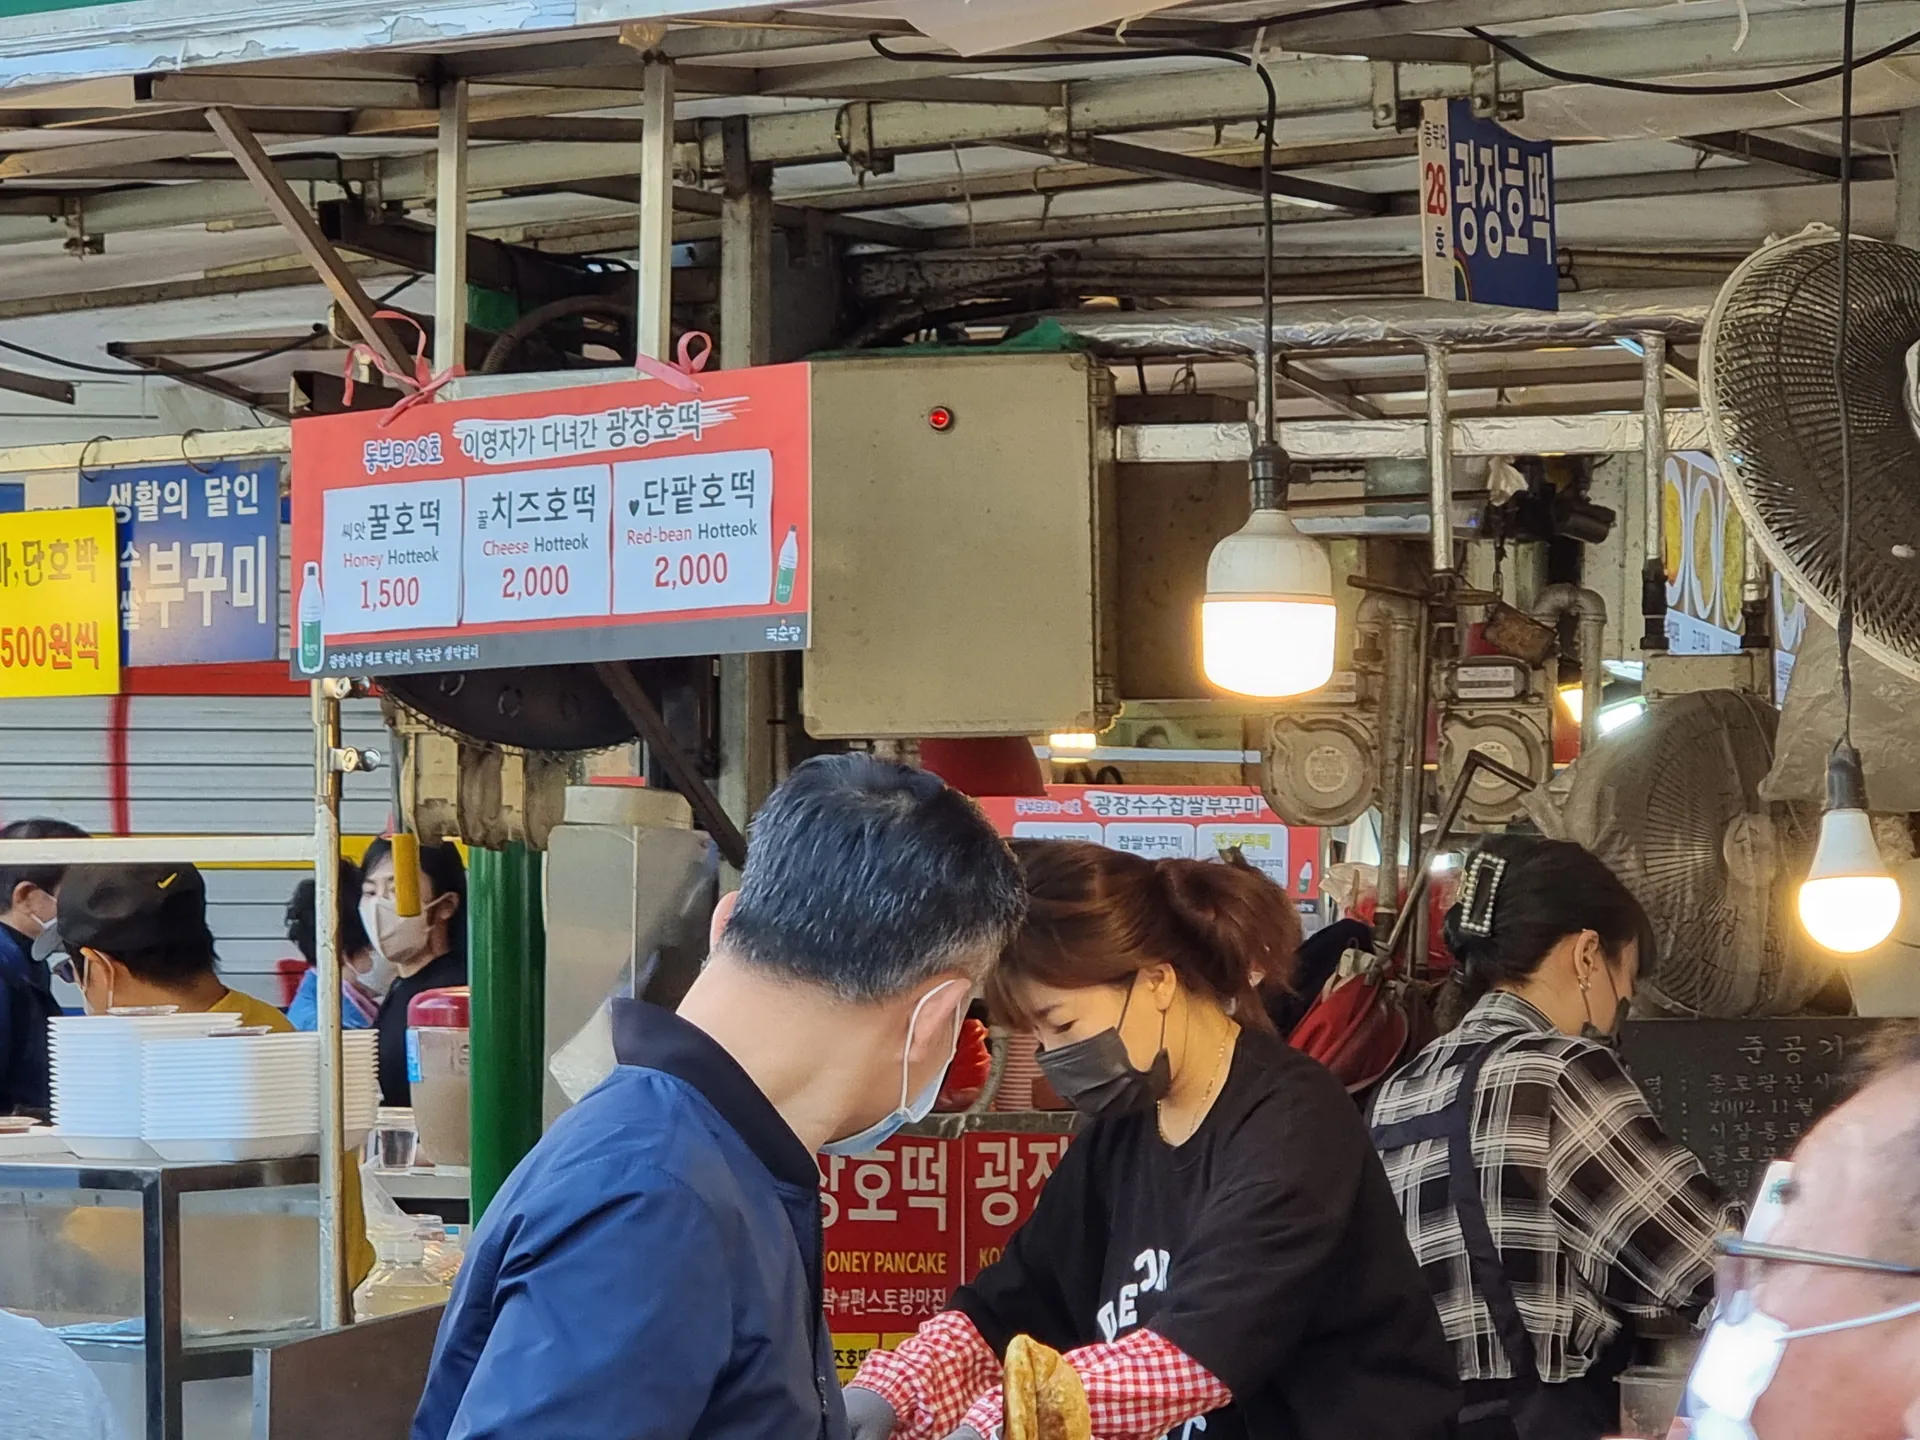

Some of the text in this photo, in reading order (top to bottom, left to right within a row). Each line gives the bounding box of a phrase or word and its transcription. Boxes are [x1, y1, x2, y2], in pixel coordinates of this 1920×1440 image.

[1425, 162, 1447, 216] 28
[1455, 139, 1552, 265] 광장호떡
[463, 402, 702, 461] 이영자가 다녀간 광장호떡
[363, 433, 443, 474] 동부B28호
[107, 474, 259, 524] 생활의 달인
[644, 469, 755, 516] 단팥호떡
[482, 532, 589, 556] Cheese Hotteok
[627, 518, 758, 546] Red-bean Hotteok
[343, 545, 439, 571] Honey Hotteok
[654, 551, 728, 590] 2,000
[146, 535, 267, 628] 부꾸미
[360, 576, 420, 612] 1,500
[502, 564, 569, 601] 2,000
[765, 624, 801, 642] 국순당
[1095, 795, 1260, 815] 광장수수찹쌀부꾸미
[1117, 834, 1183, 851] 찹쌀부꾸미
[824, 1250, 947, 1275] ONEY PANCAKE
[980, 1247, 1006, 1268] KO
